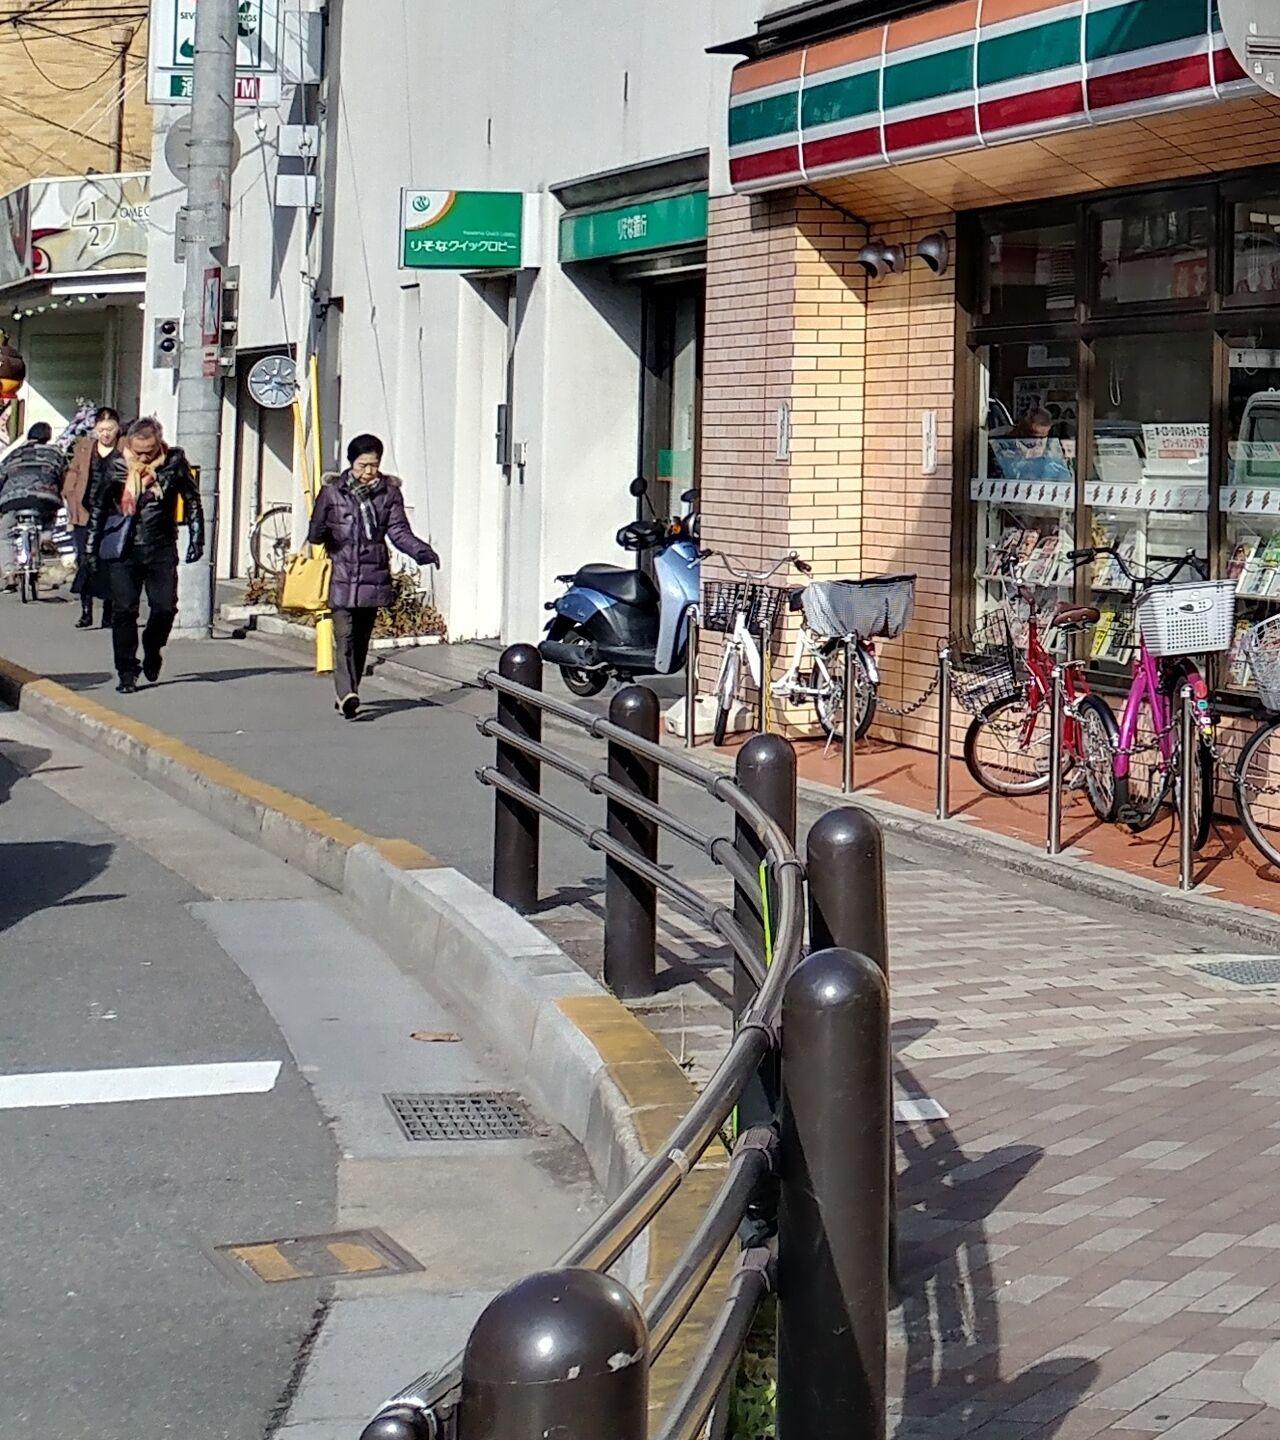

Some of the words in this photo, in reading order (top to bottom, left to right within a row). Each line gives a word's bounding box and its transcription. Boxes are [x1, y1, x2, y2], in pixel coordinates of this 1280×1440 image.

[410, 240, 517, 252] りそなクイックロビー
